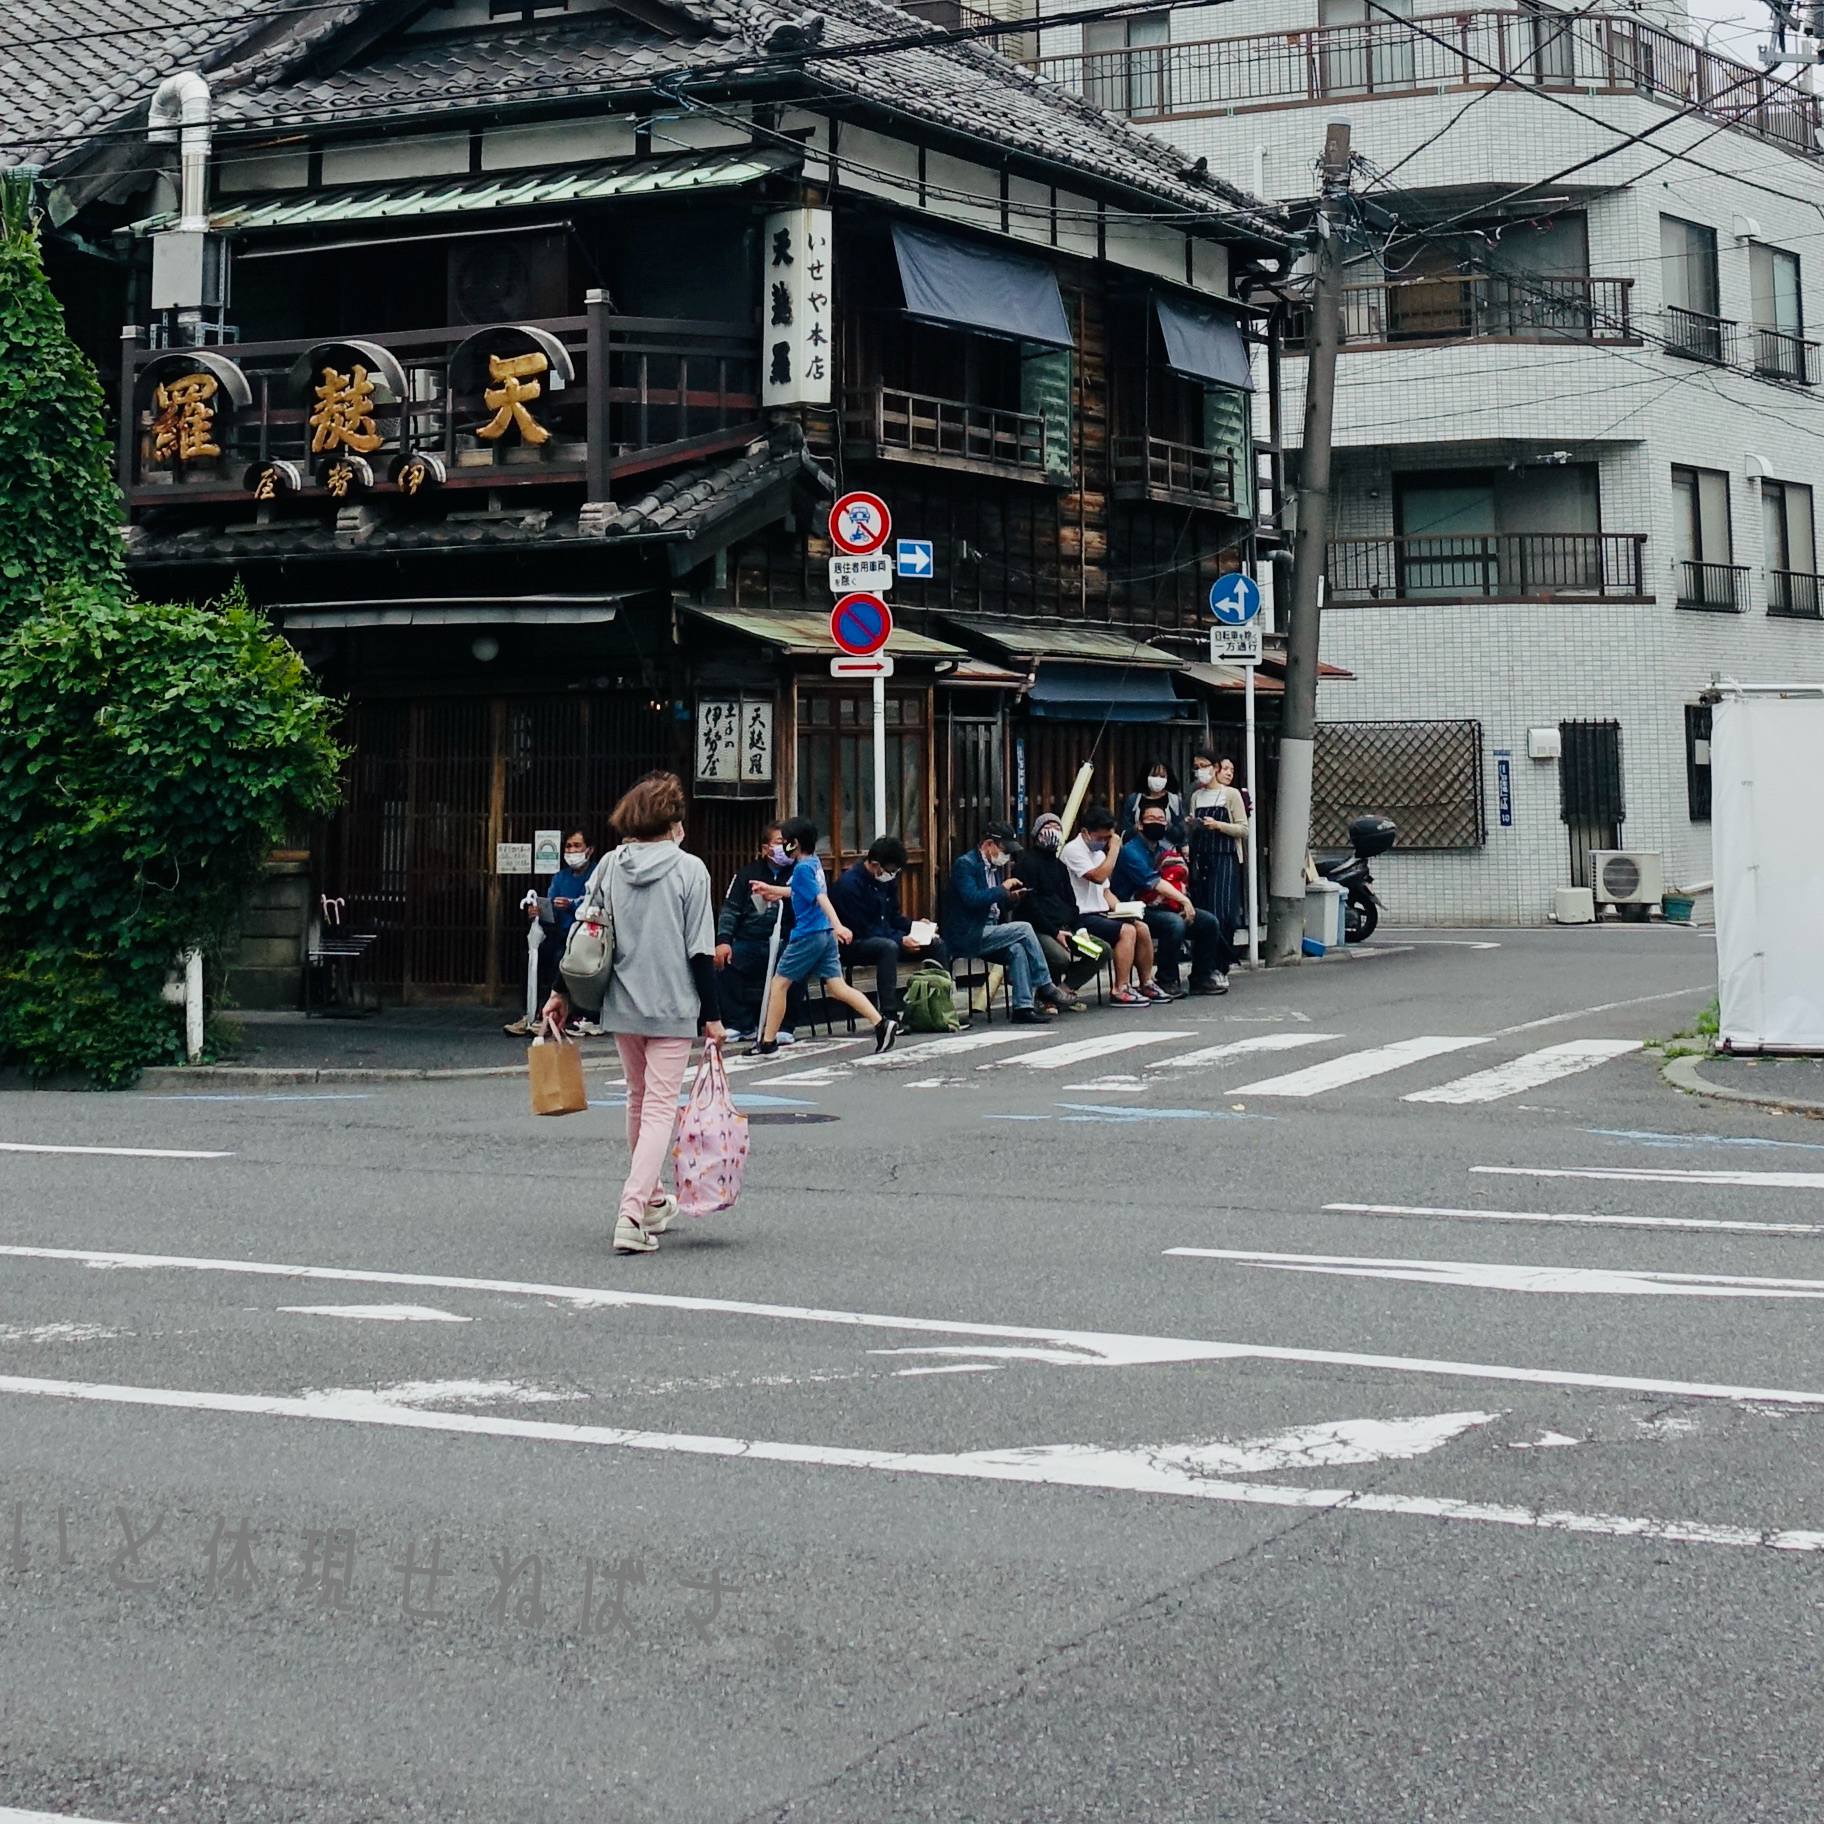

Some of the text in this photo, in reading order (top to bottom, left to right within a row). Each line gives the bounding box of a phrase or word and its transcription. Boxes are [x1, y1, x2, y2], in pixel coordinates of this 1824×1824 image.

[805, 232, 828, 380] いせや本店
[1214, 642, 1258, 652] 一方通行
